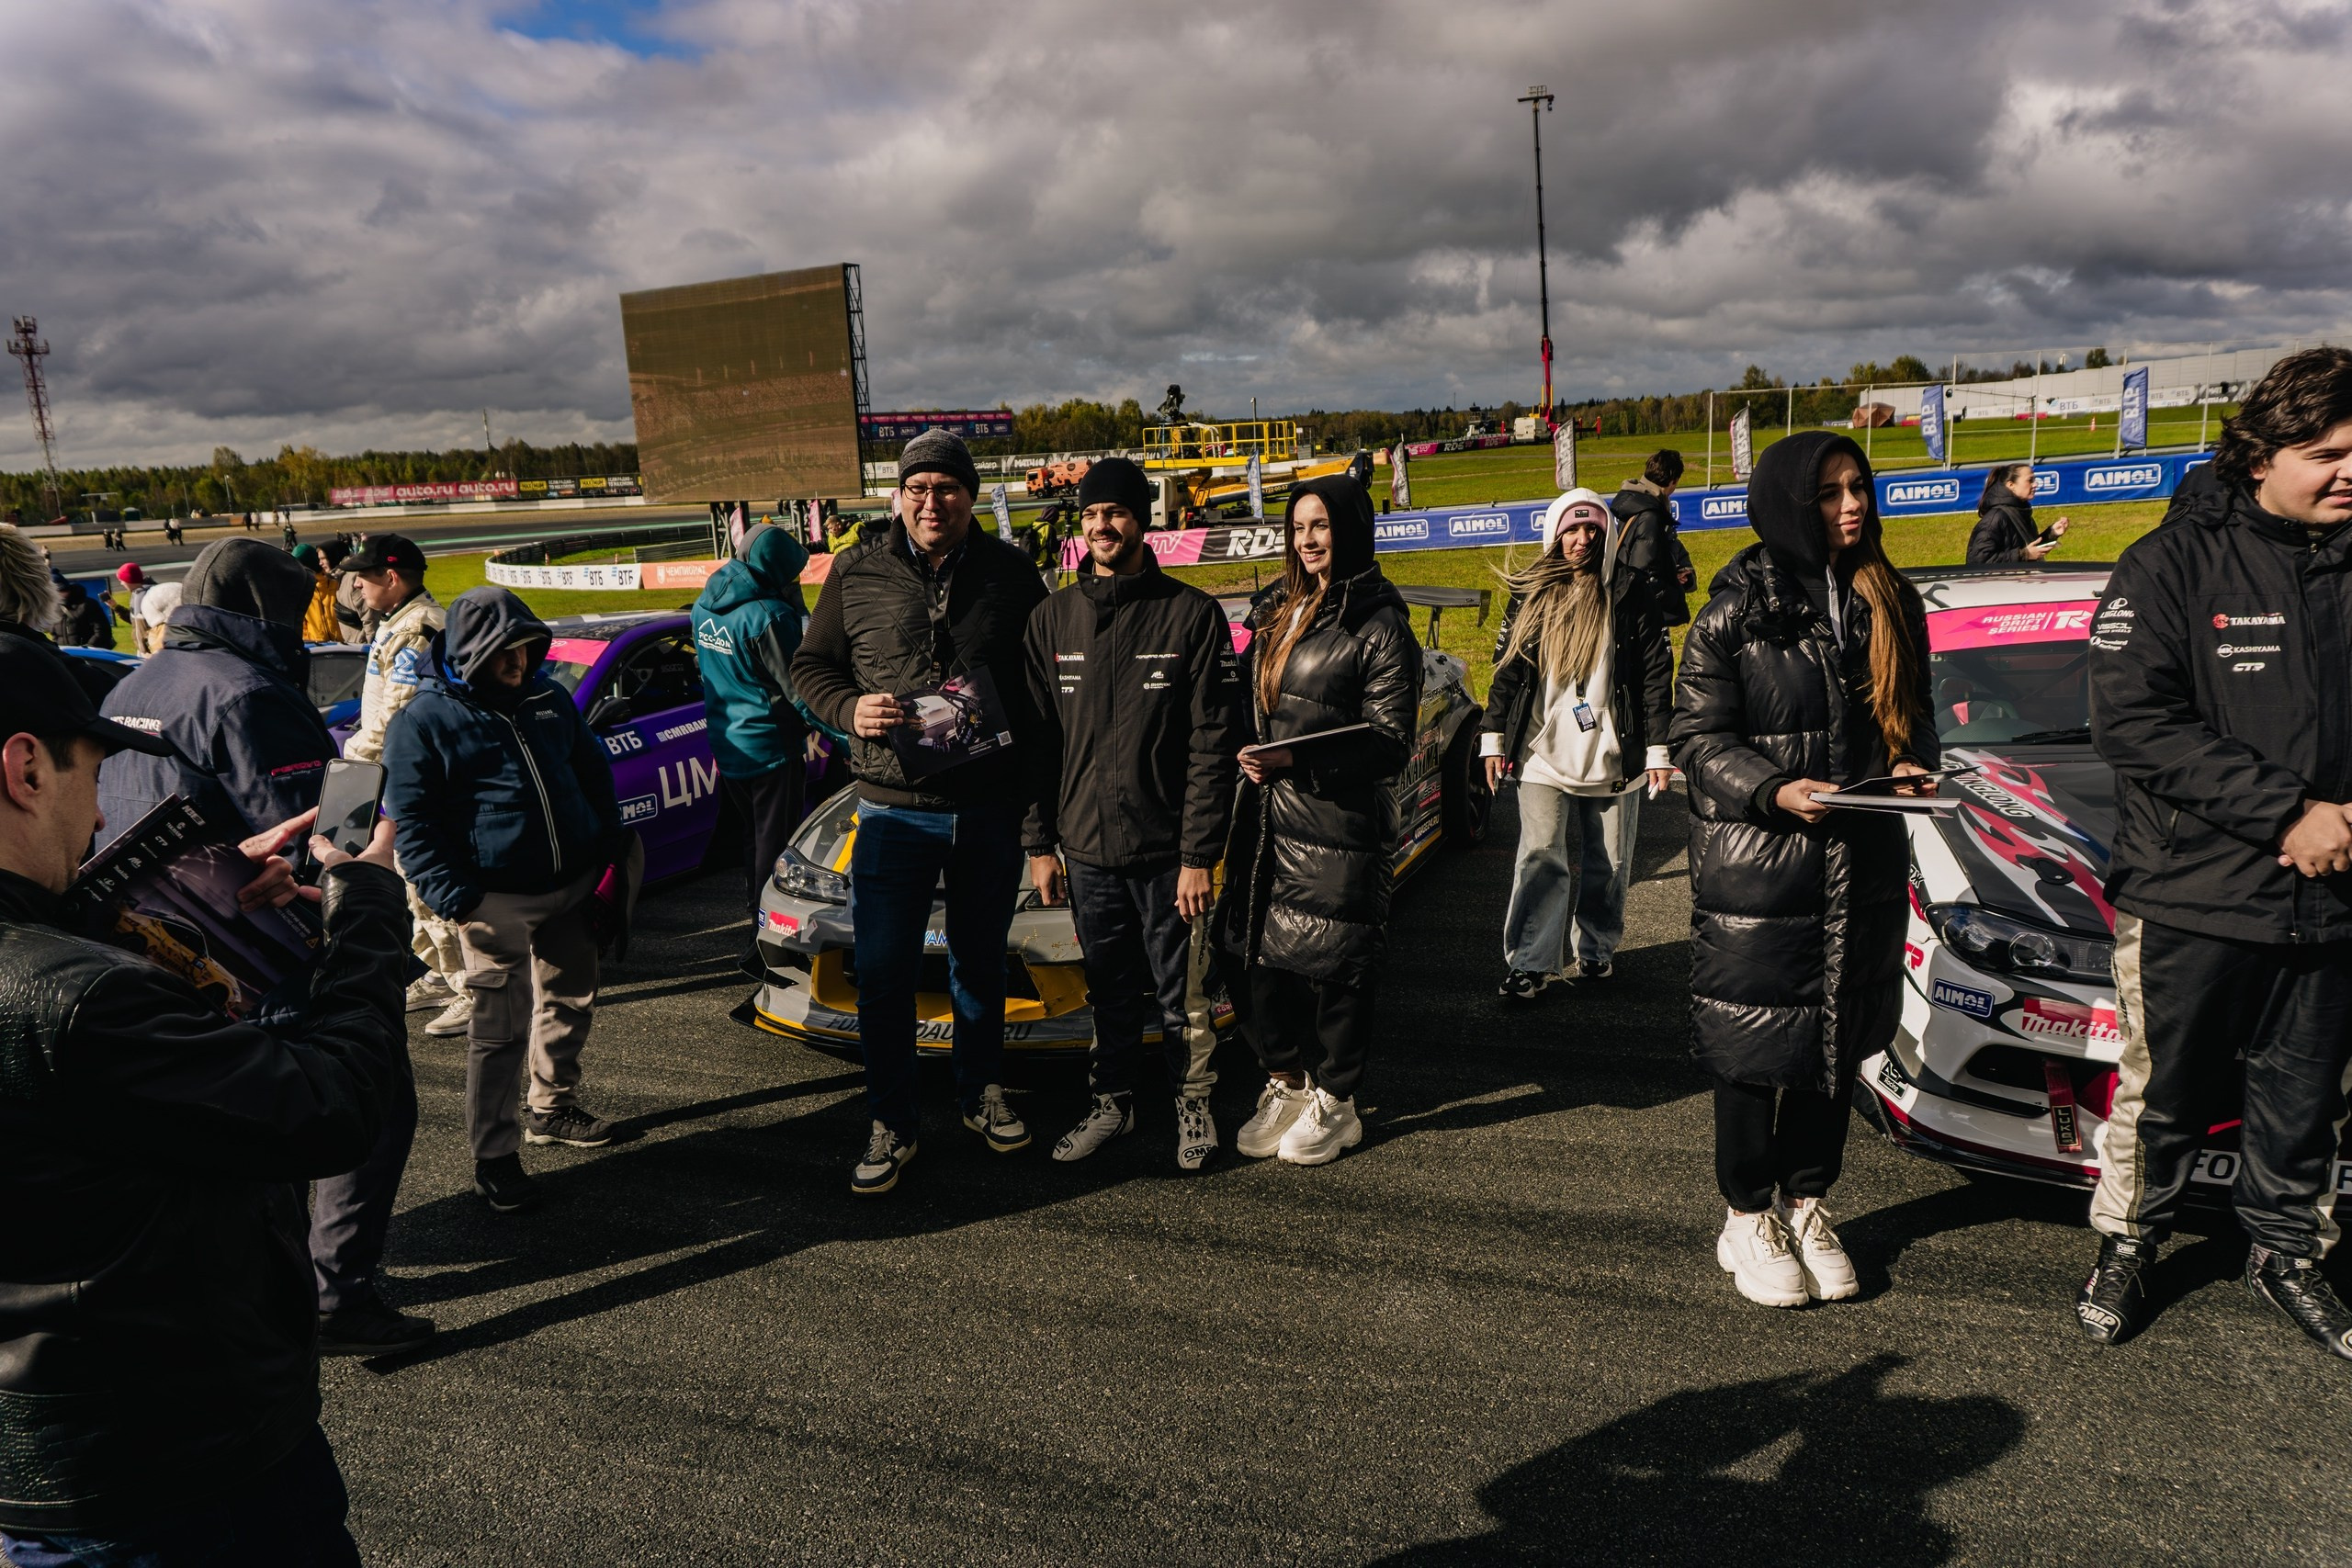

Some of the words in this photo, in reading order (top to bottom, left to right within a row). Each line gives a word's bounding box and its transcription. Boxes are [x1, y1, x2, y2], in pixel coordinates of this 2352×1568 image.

[2060, 400, 2078, 411] ВТБ
[879, 426, 895, 437] ВТБ
[975, 423, 989, 434] ВТБ
[1443, 442, 1464, 452] RDS
[882, 466, 894, 474] ВТБ
[974, 460, 997, 469] сайдер
[2090, 468, 2157, 486] AIMOL
[396, 485, 453, 498] auto.ru
[458, 480, 514, 494] auto.ru
[1890, 483, 1956, 502] AIMOL
[1706, 501, 1747, 515] AIM
[1375, 524, 1425, 537] AIMOL
[1453, 517, 1506, 533] AIMOL
[1152, 534, 1183, 555] TV
[665, 564, 706, 576] ЧЕМПИОНАТ
[590, 570, 604, 586] ВТБ
[618, 570, 634, 586] ВТБ
[1982, 612, 2048, 625] RUSSIAN
[2000, 618, 2041, 627] DRIFT
[2230, 615, 2286, 626] TAKAYAMA
[1987, 625, 2041, 635] SERIES
[2233, 645, 2281, 654] KASHIYAMA
[124, 716, 163, 732] RACING
[664, 717, 707, 740] CMRBAN
[604, 730, 643, 756] ВТБ
[623, 799, 655, 819] MOL
[1935, 982, 1989, 1011] AIMOL
[2117, 1244, 2137, 1253] OMP
[2294, 1259, 2312, 1268] OMP
[2078, 1303, 2118, 1328] OMP
